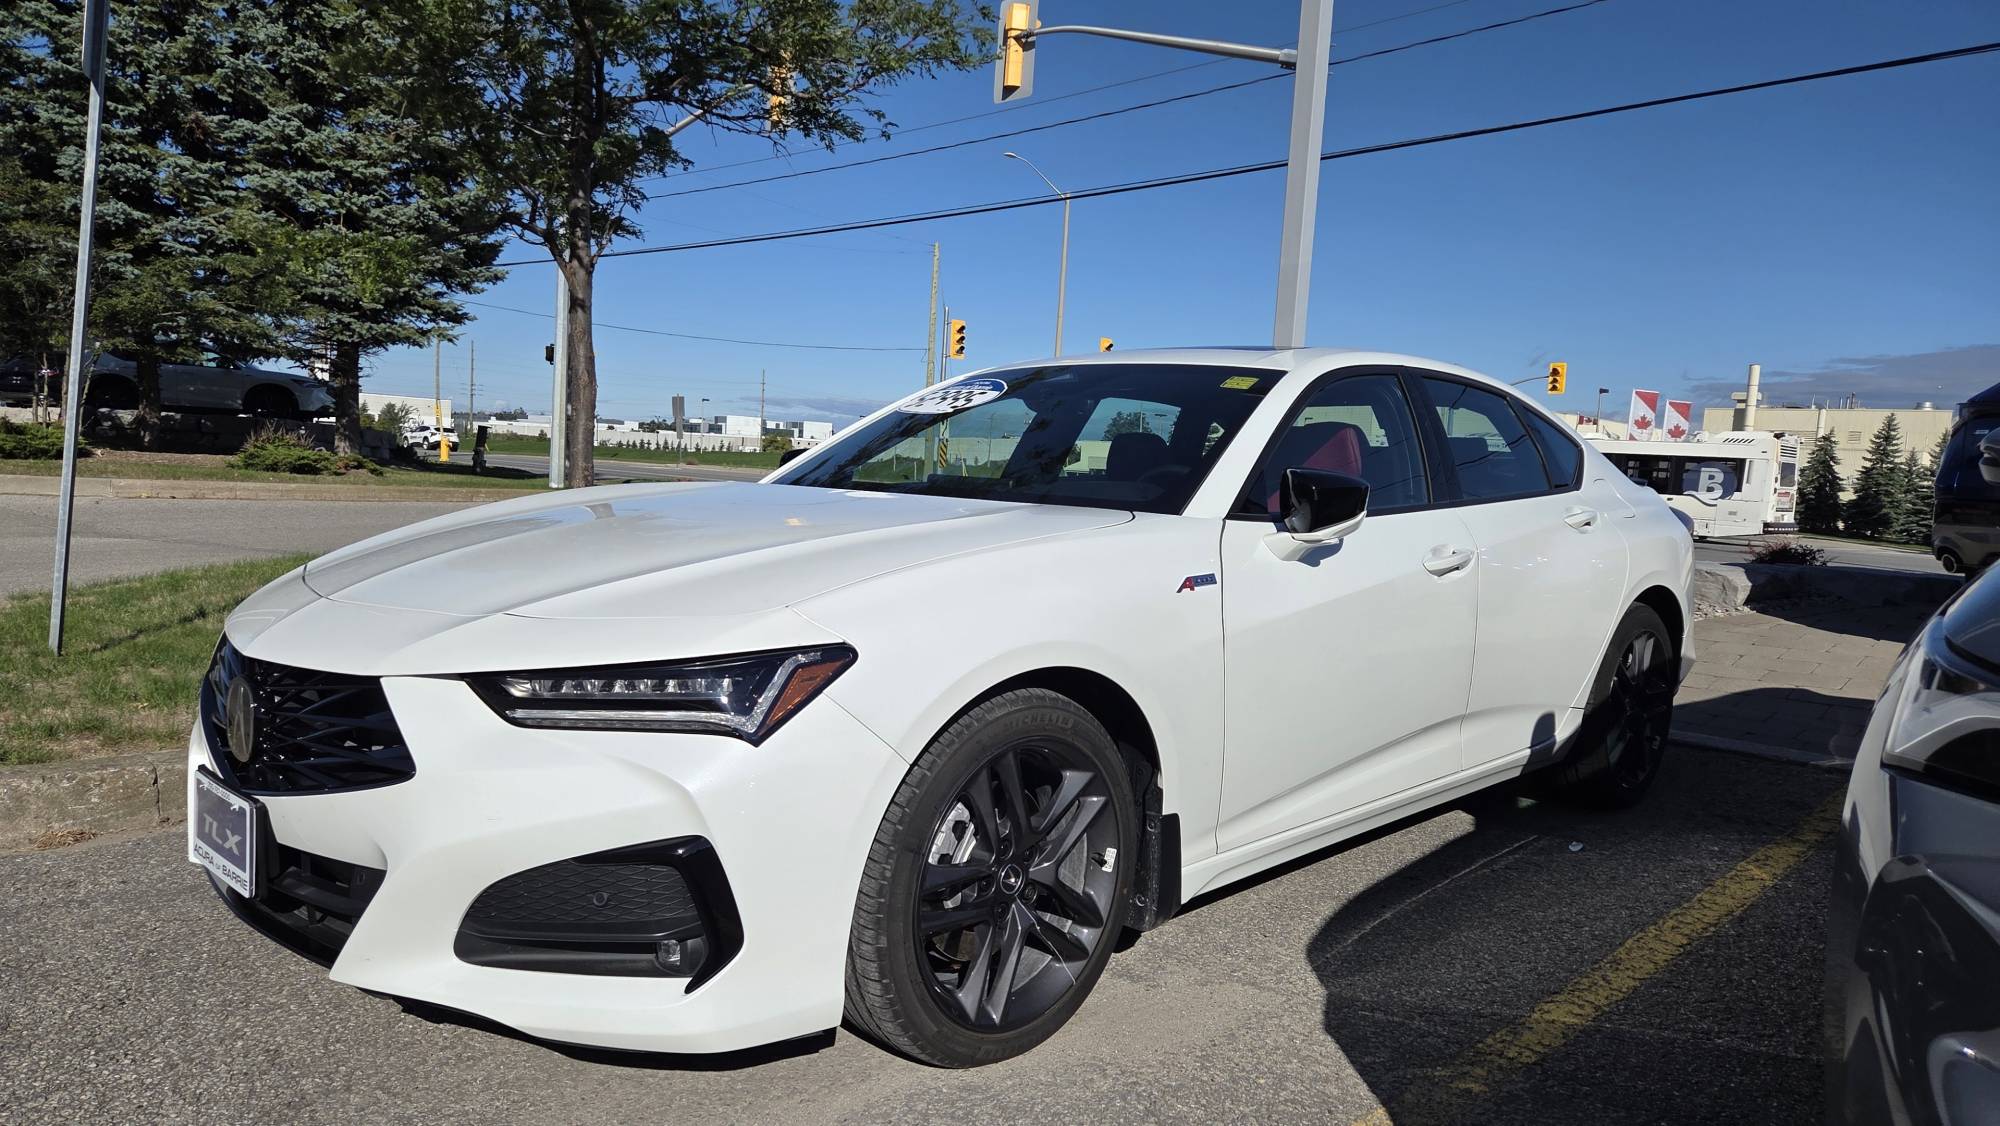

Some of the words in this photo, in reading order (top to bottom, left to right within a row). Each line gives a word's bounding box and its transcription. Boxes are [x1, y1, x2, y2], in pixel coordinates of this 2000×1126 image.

[1700, 467, 1725, 500] B
[203, 813, 243, 857] TLX
[194, 842, 214, 867] ACURA
[222, 864, 248, 892] BARRIE
